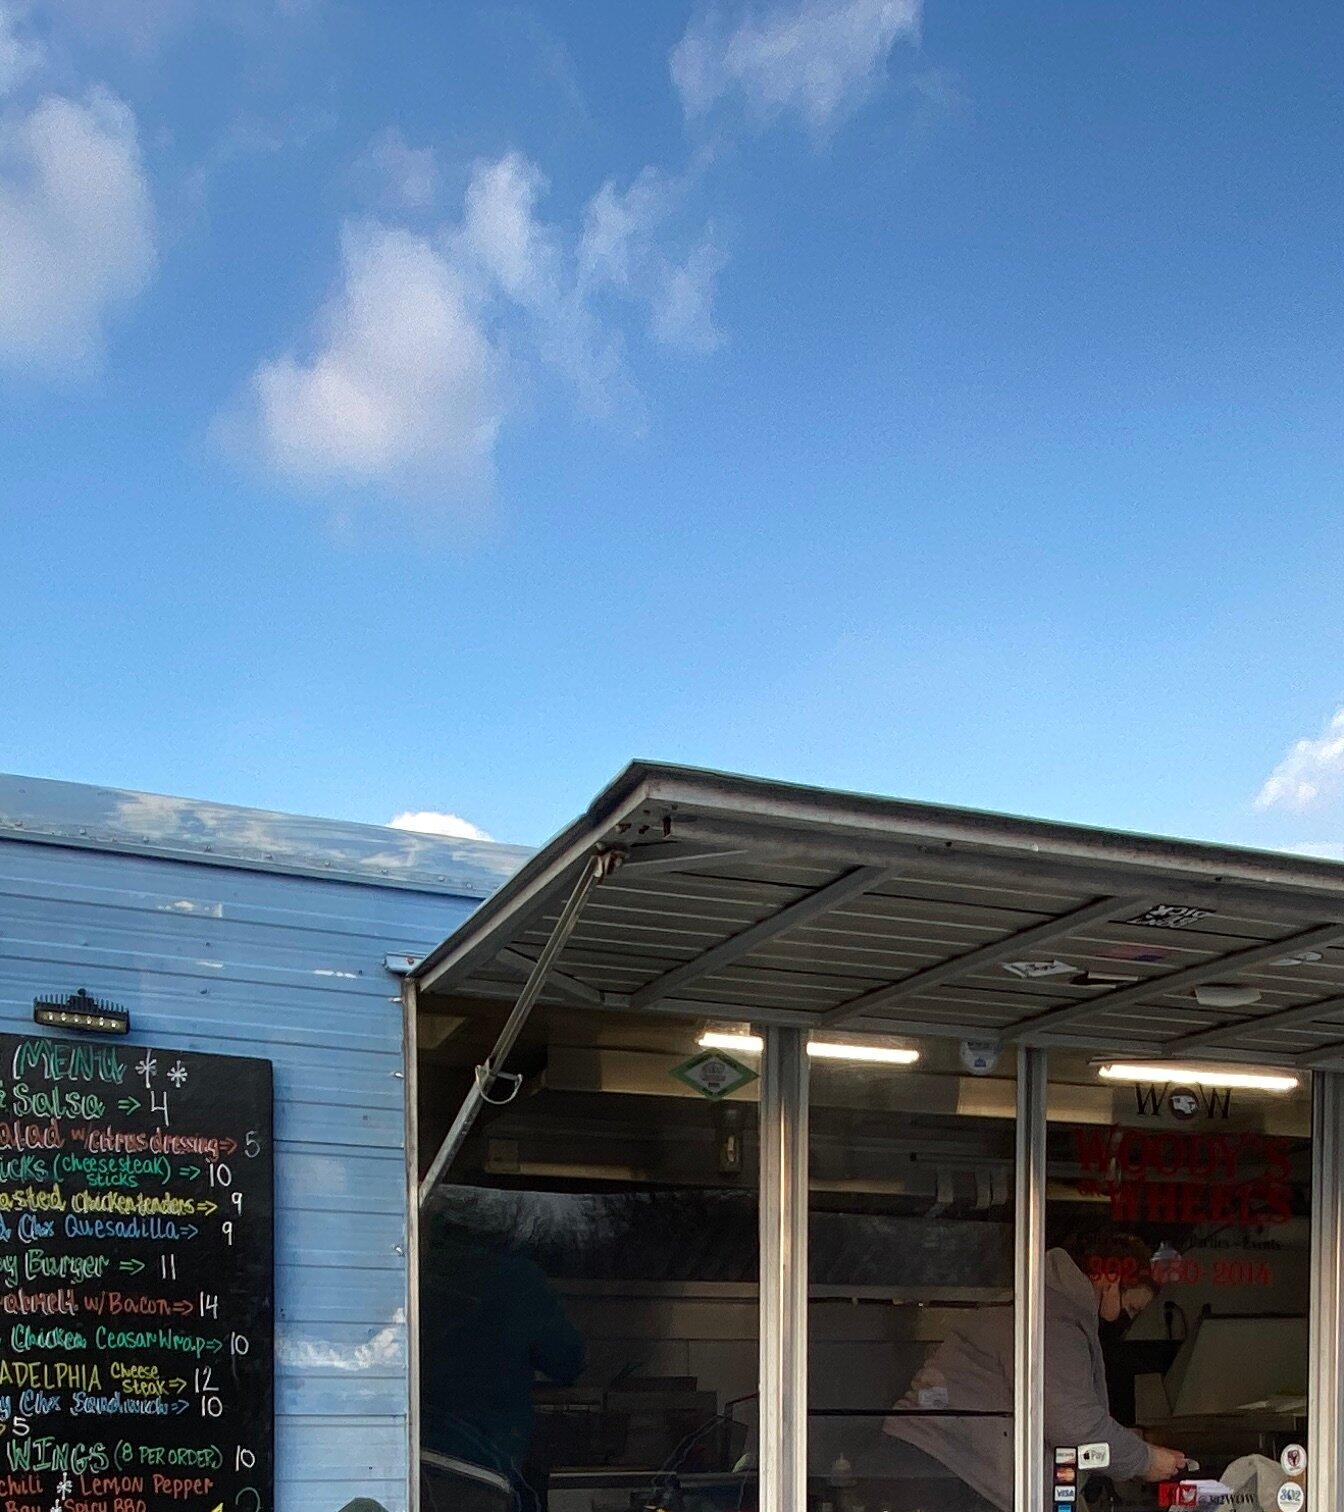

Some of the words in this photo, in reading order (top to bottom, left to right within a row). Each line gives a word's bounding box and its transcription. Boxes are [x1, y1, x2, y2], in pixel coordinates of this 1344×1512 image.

[150, 1090, 170, 1127] 4
[244, 1130, 261, 1158] 5
[208, 1162, 233, 1188] 10
[231, 1191, 244, 1217] 9
[64, 1213, 182, 1240] Quesadilla
[221, 1220, 234, 1246] 9
[160, 1253, 177, 1281] 11
[199, 1290, 219, 1320] 14
[229, 1331, 250, 1356] 10
[194, 1365, 220, 1394] 12
[200, 1395, 224, 1418] 10
[11, 1415, 30, 1437] 5
[235, 1444, 256, 1472] 10
